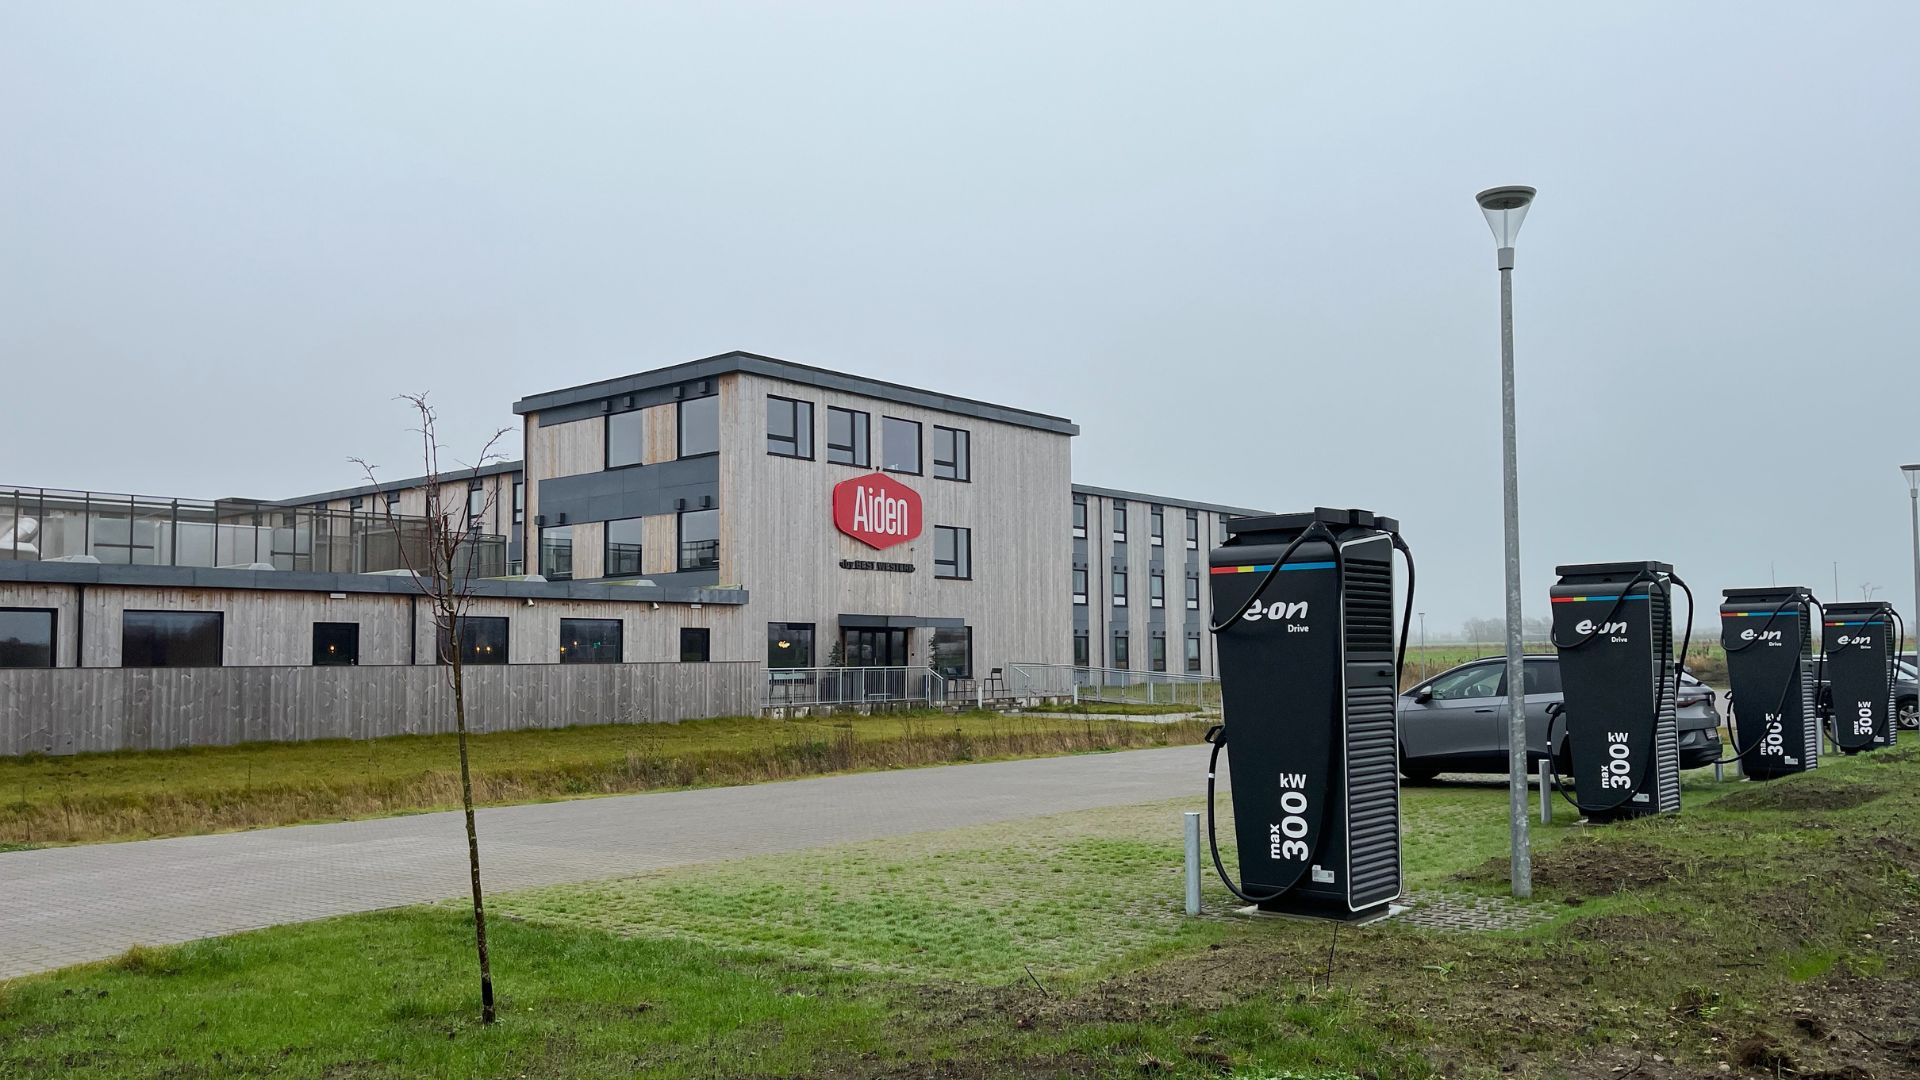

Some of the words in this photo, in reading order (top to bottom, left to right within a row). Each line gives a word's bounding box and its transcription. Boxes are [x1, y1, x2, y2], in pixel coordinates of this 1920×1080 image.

[853, 485, 908, 536] Aiden
[1287, 624, 1310, 633] Drive
[1858, 708, 1873, 735] 300
[1607, 732, 1629, 743] kW
[1766, 722, 1784, 756] 300
[1279, 773, 1307, 789] kW
[1601, 765, 1610, 789] max
[1608, 743, 1632, 790] 300
[1270, 823, 1281, 860] max
[1280, 791, 1309, 862] 300
